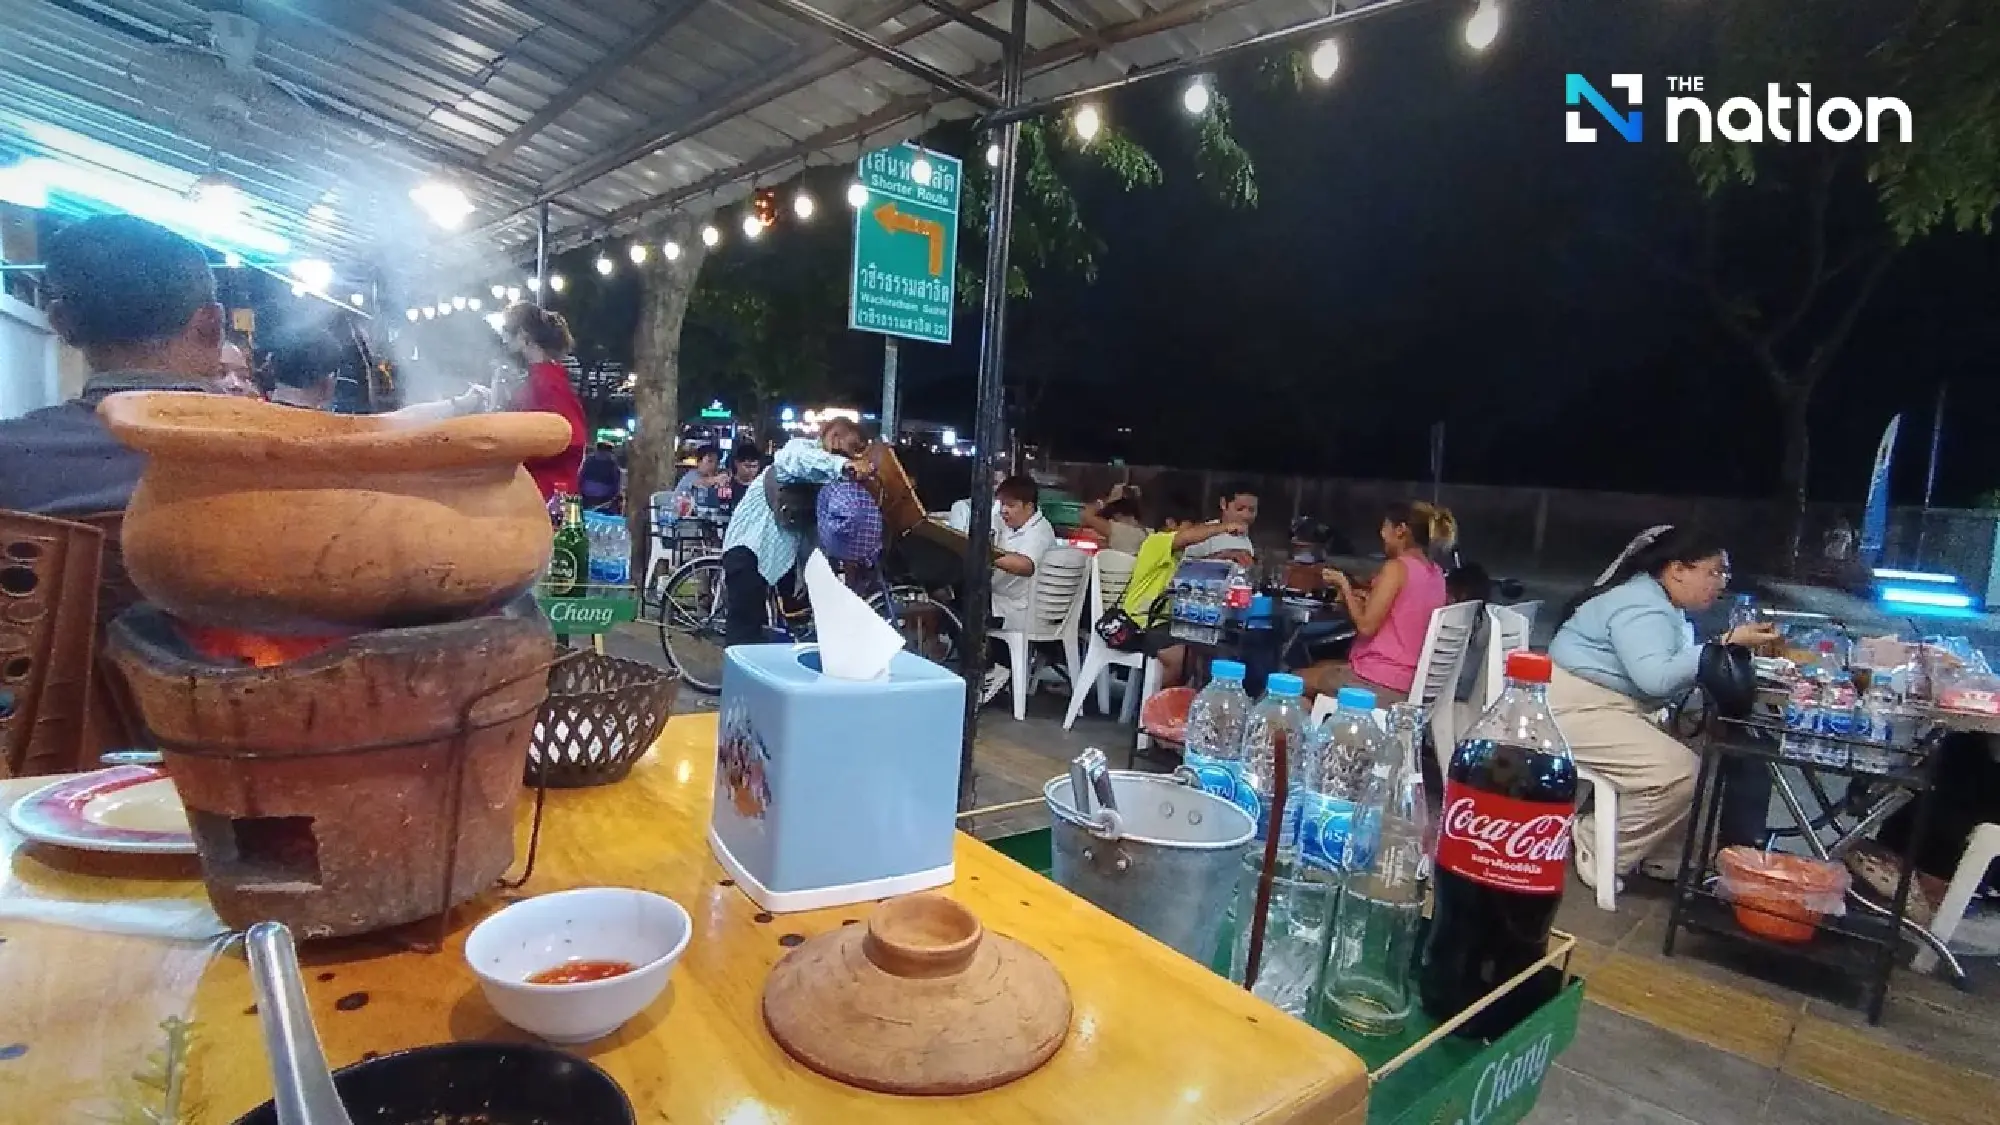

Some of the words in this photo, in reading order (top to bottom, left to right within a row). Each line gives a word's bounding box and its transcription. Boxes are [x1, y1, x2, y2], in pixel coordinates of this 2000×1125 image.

[866, 148, 955, 193] เส้นทลัด
[871, 174, 912, 195] Shorter
[917, 187, 949, 206] Route
[550, 602, 613, 625] Chang
[1470, 1033, 1552, 1125] Chang
